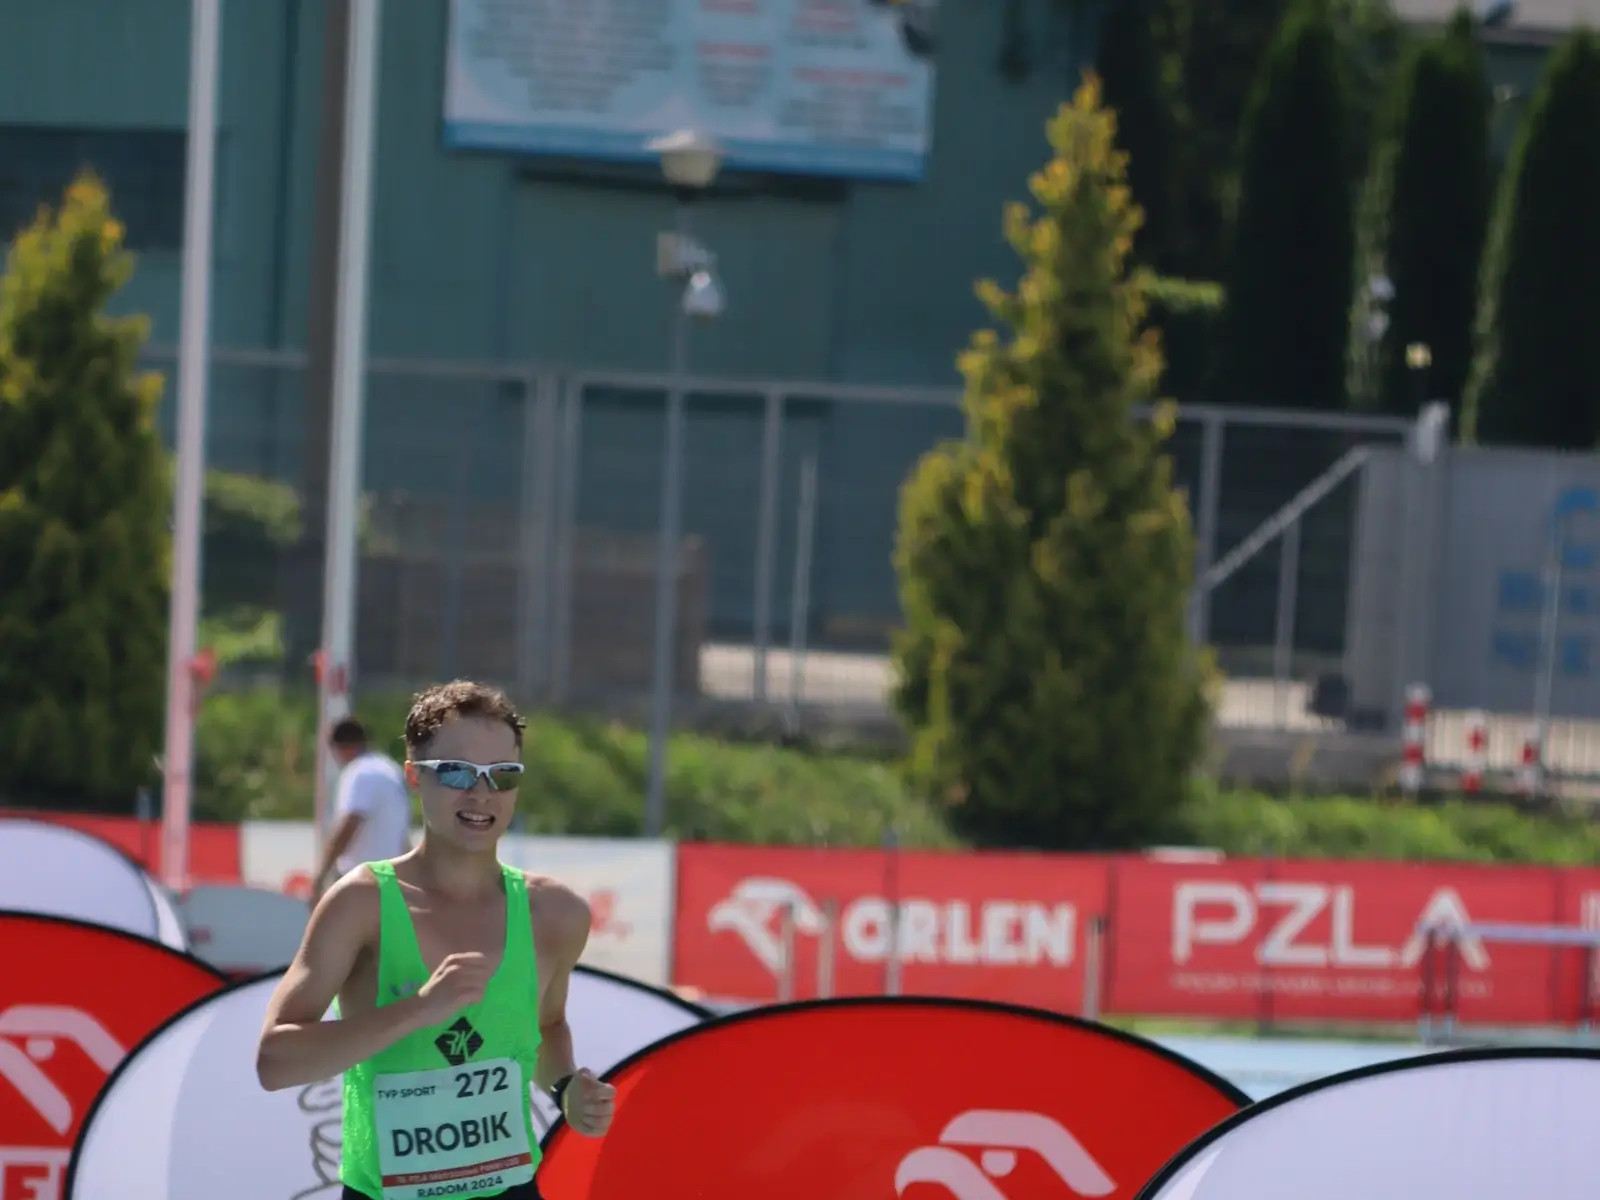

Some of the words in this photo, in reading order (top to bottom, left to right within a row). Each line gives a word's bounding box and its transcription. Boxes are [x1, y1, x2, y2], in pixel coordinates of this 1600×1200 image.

[842, 896, 1076, 967] ORLEN
[1172, 881, 1491, 970] PZLA
[378, 1088, 398, 1099] TVP
[400, 1085, 436, 1098] SPORT
[455, 1066, 508, 1098] 272
[392, 1112, 512, 1157] DROBIK
[417, 1183, 468, 1198] RADOM
[471, 1176, 503, 1191] 2024
